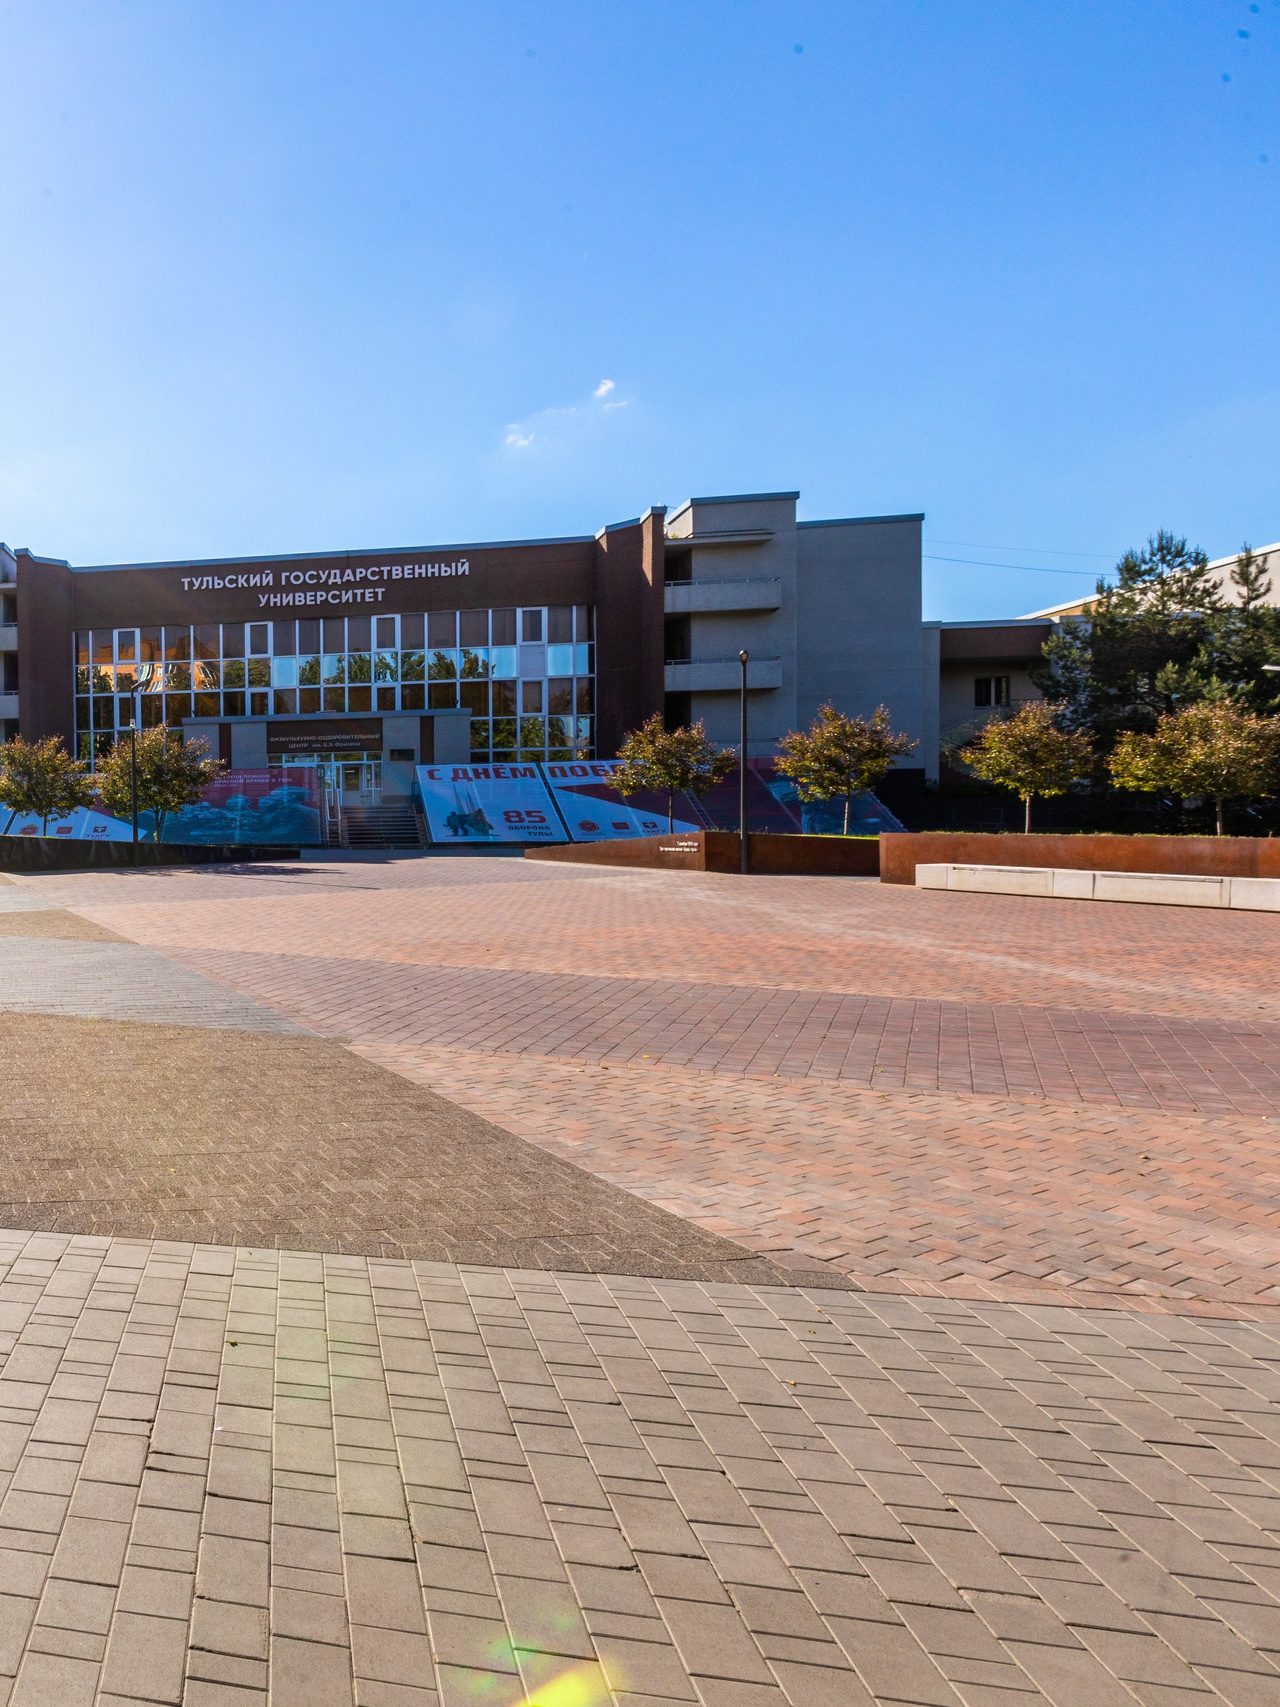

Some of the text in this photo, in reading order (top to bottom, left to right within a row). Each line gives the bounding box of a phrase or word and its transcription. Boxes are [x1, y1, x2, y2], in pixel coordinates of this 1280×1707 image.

[181, 558, 470, 591] ТУЛЬСКИЙ ГОСУДАРСТВЕННЫЙ
[258, 588, 386, 607] УНИВЕРСИТЕТ
[269, 732, 380, 742] ФИЗКУЛЬТУРНО-ОЗДОРОВИТЕЛЬНЫЙ
[427, 768, 444, 781] С
[451, 764, 537, 782] ДНЁМ
[502, 810, 547, 824] 85
